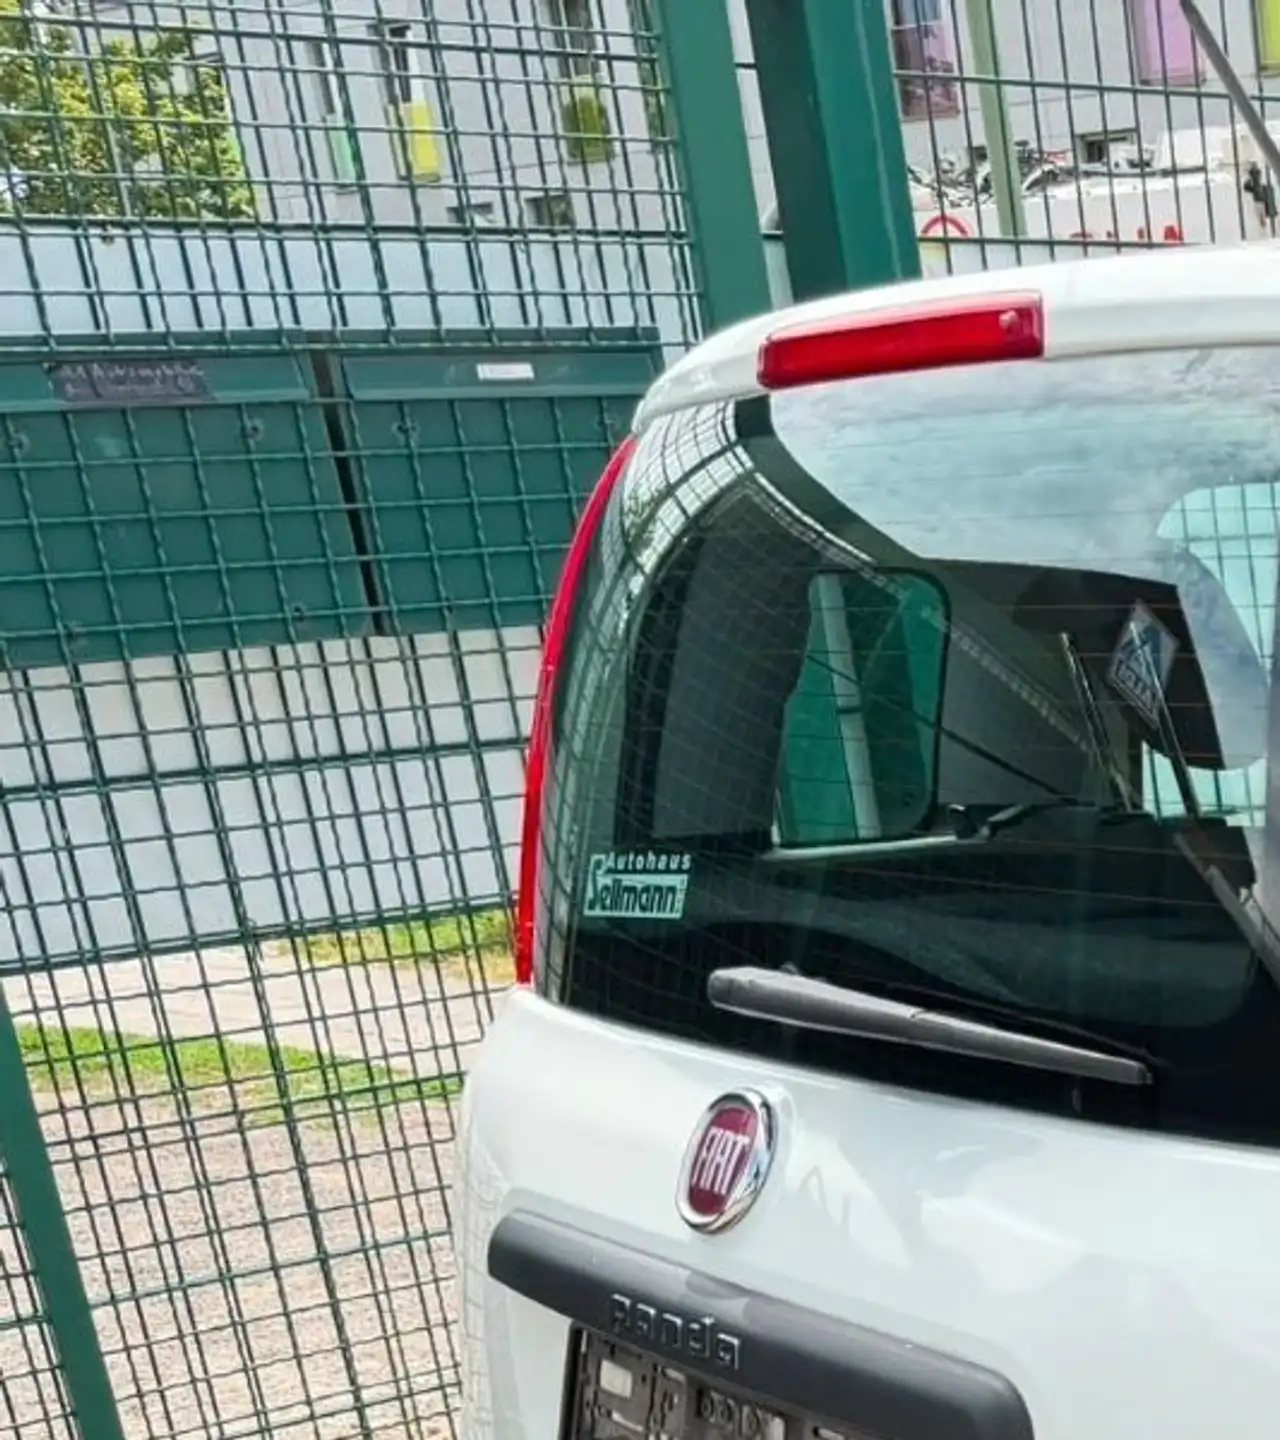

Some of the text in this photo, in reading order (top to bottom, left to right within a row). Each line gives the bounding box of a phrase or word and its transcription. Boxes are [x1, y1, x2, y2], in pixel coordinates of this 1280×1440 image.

[587, 856, 679, 914] Sellmann
[604, 851, 692, 871] Autohaus
[690, 1125, 751, 1196] FIAT
